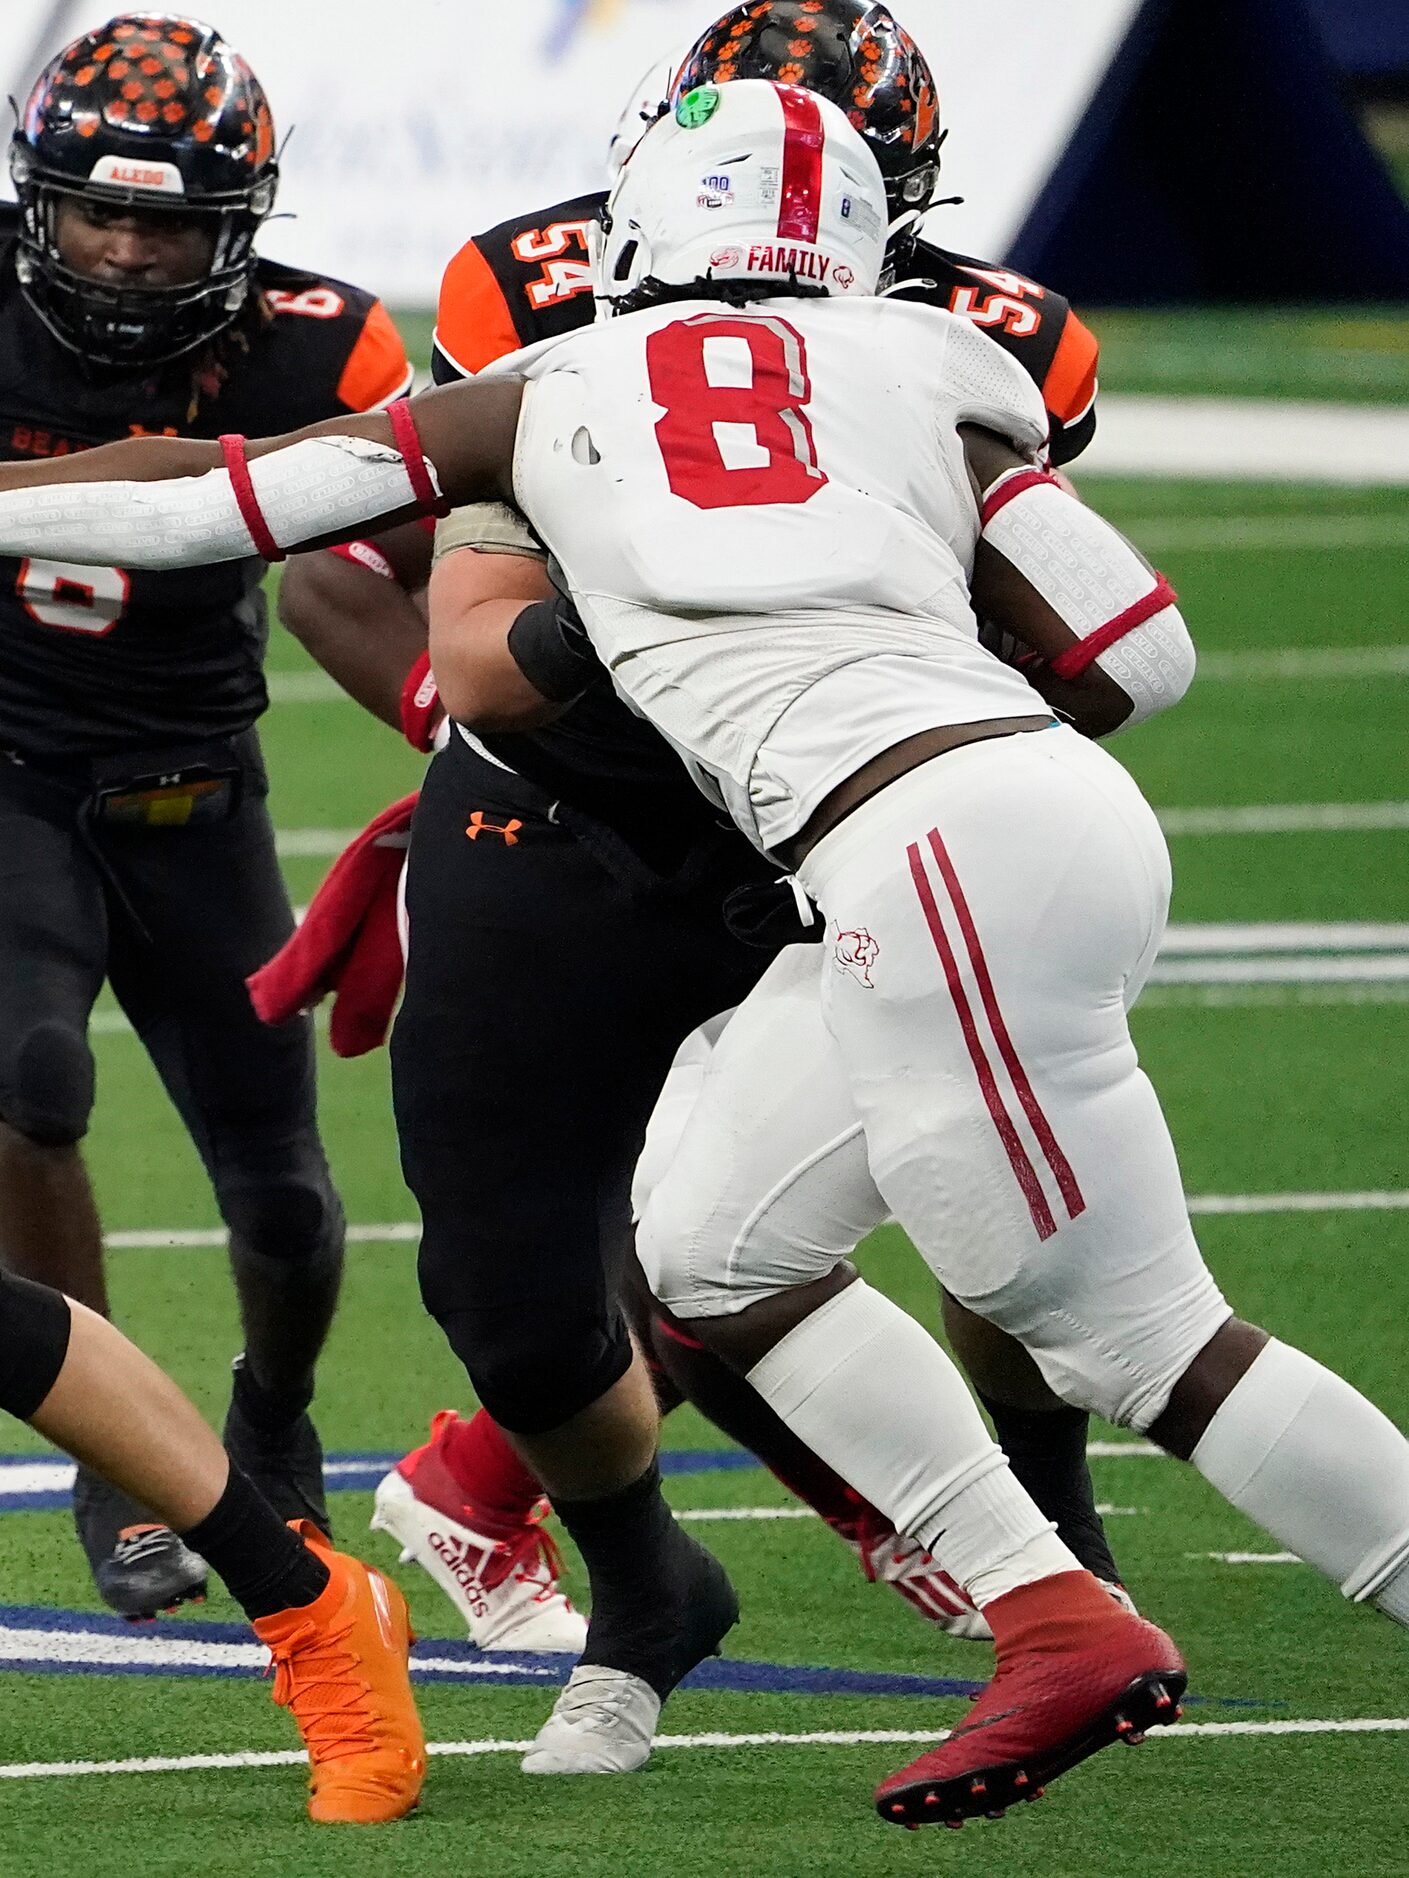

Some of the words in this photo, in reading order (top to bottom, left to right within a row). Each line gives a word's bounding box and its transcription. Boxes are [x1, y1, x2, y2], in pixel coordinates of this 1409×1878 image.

[110, 166, 164, 186] ALEDO
[510, 219, 595, 311] 54
[746, 245, 831, 282] FAMILY
[948, 264, 1045, 337] 54
[645, 313, 830, 510] 8
[428, 1531, 490, 1618] adidas
